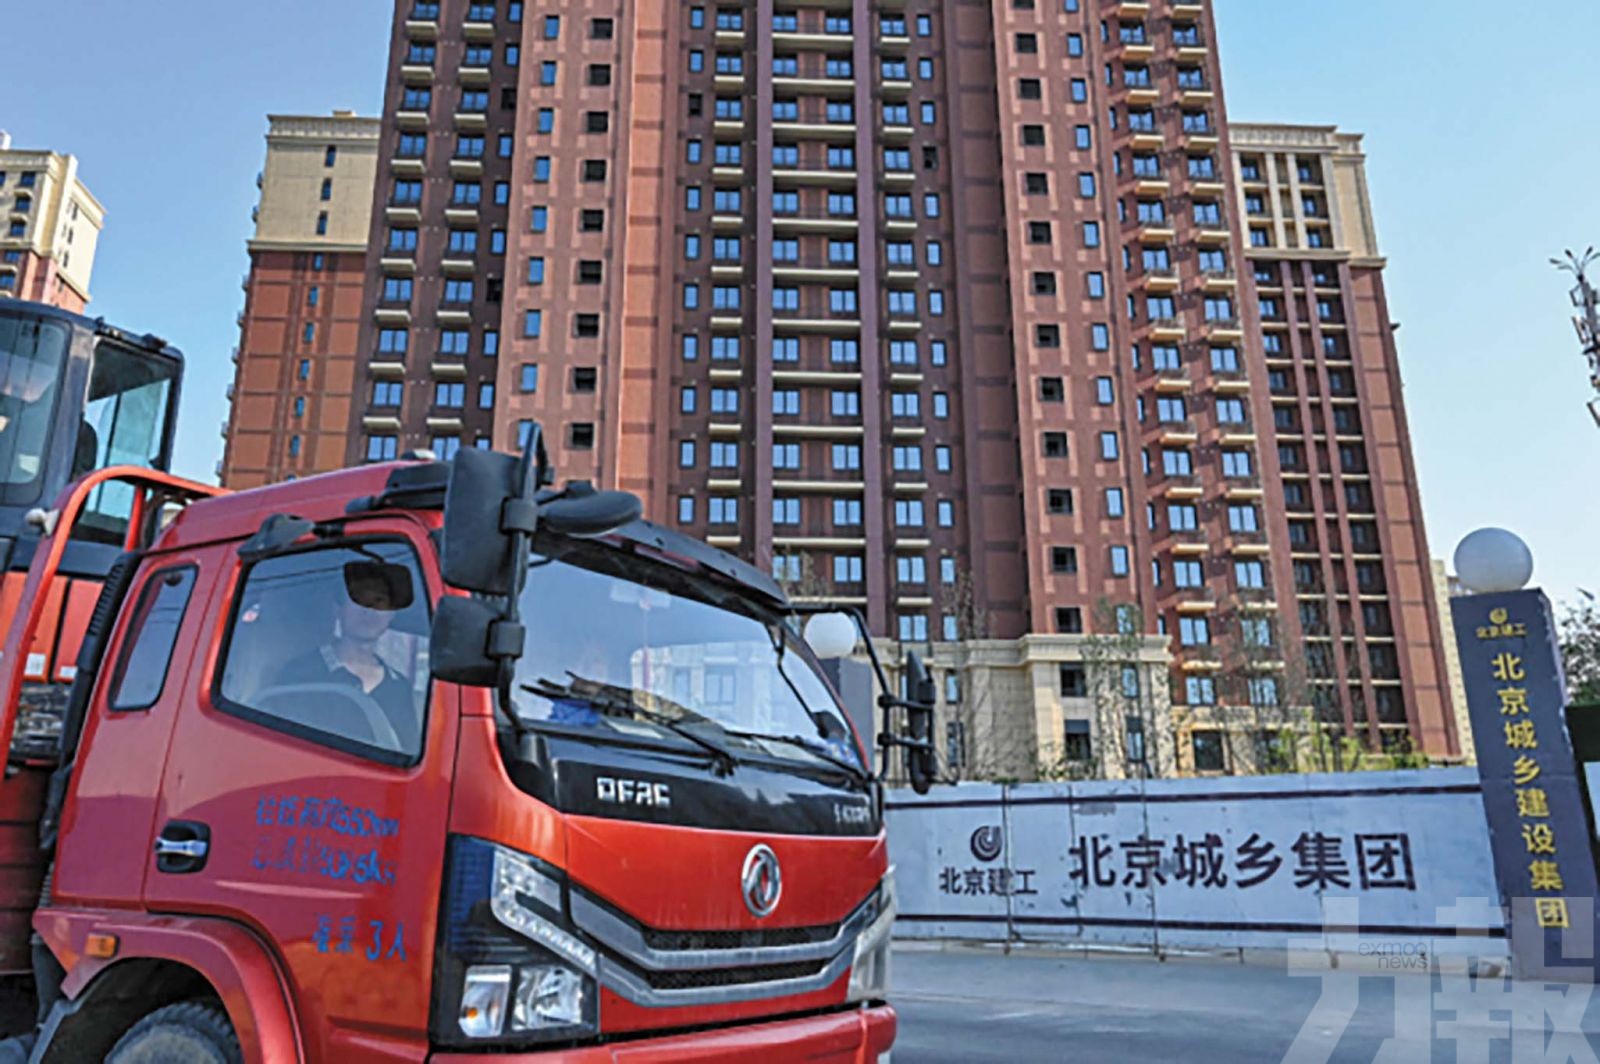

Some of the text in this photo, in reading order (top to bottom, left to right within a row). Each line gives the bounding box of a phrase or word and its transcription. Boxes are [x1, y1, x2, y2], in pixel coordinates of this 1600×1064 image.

[1491, 652, 1570, 928] 北京城乡建设集团
[939, 866, 1039, 897] 北京建工
[1069, 831, 1418, 892] 北京城乡集团
